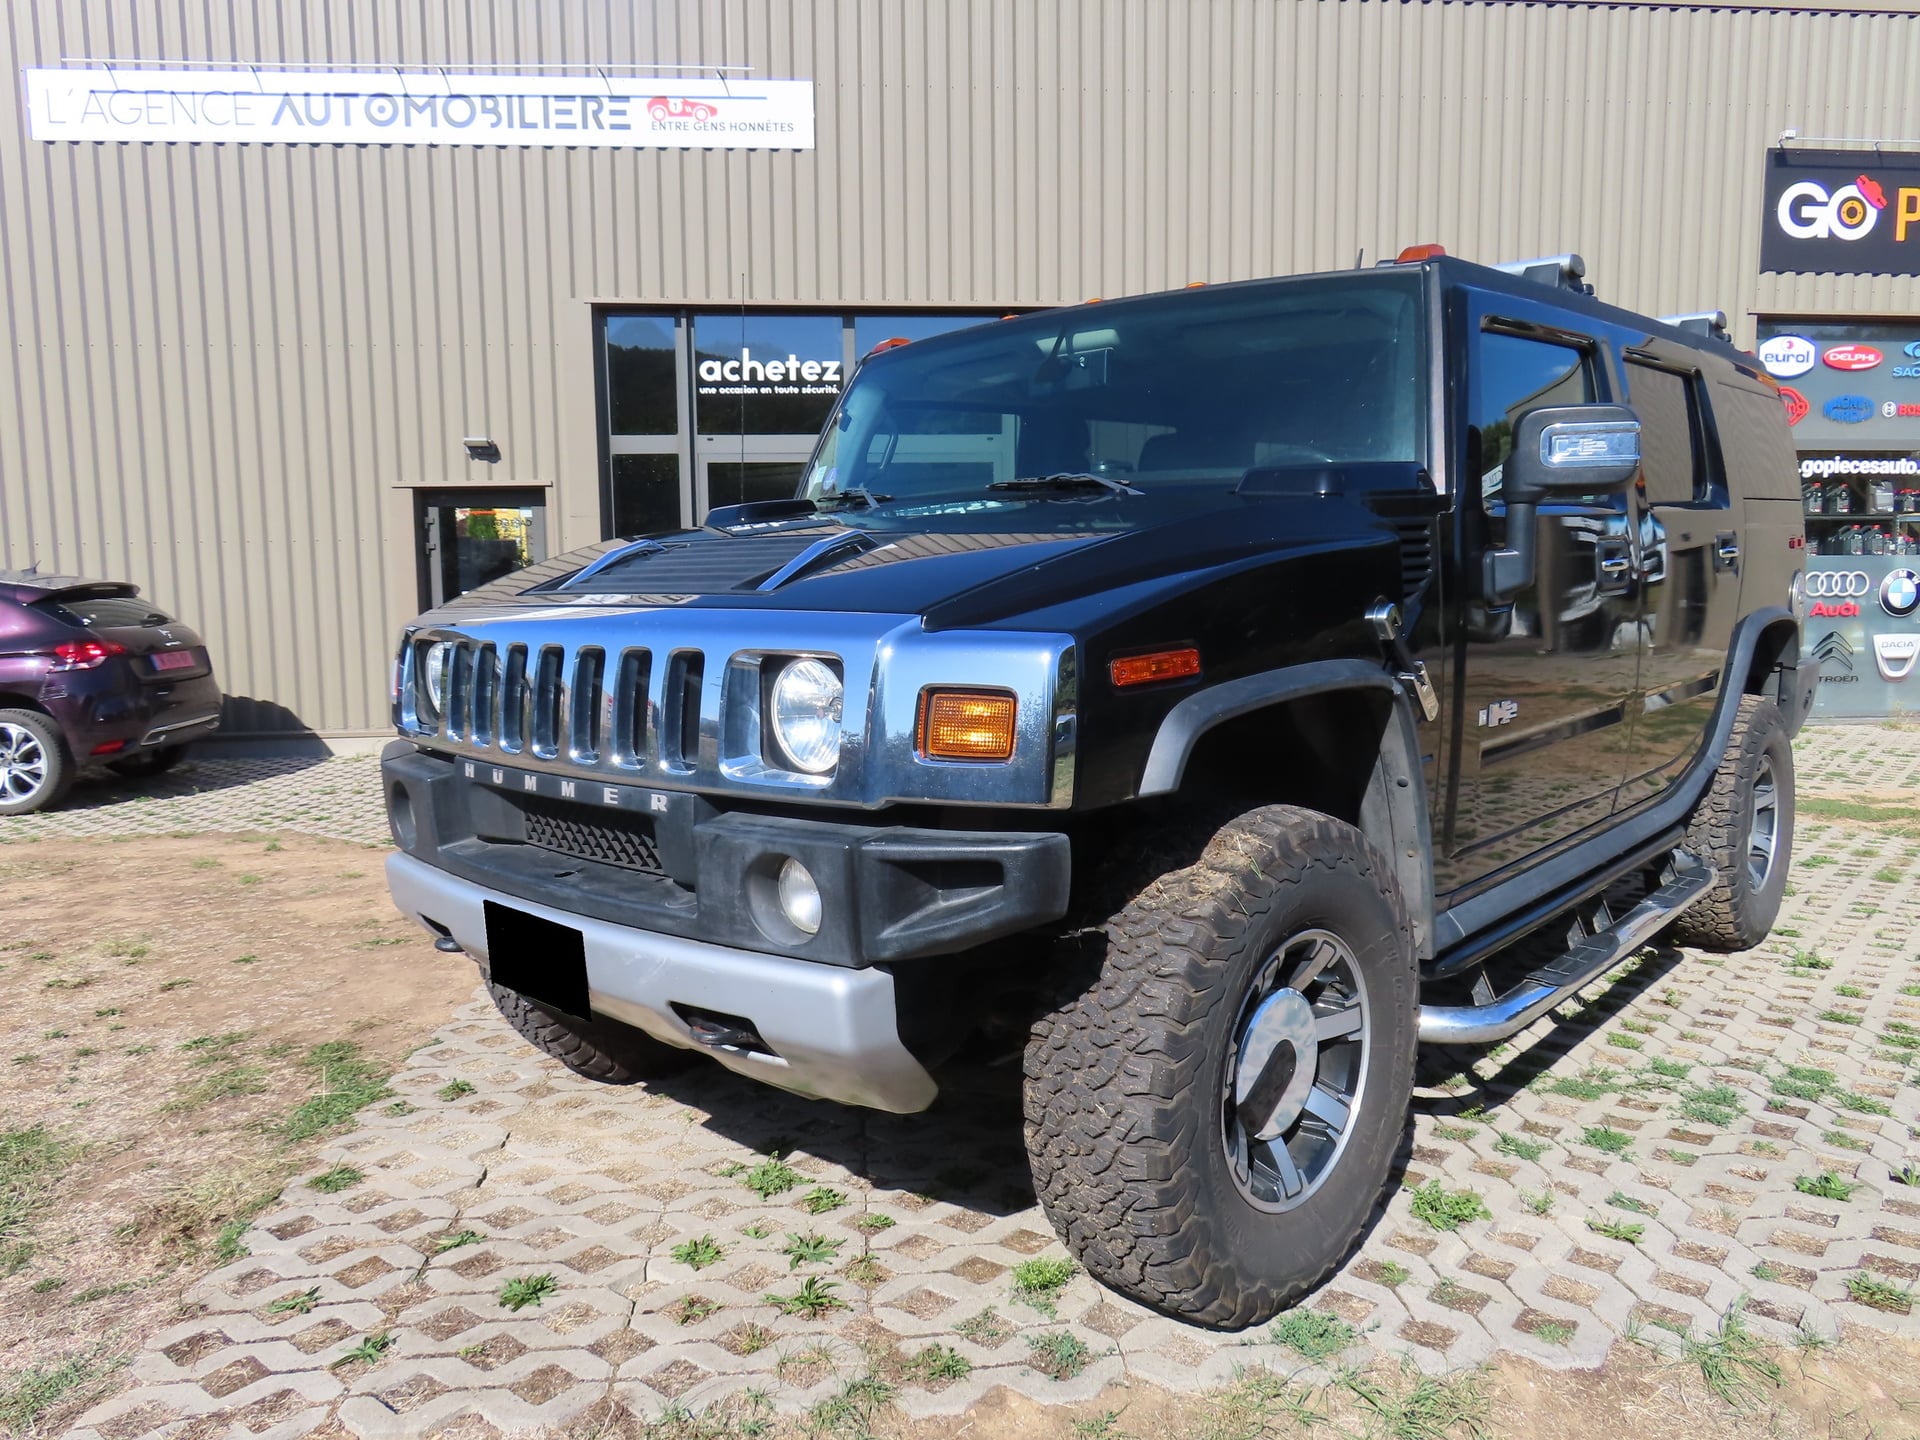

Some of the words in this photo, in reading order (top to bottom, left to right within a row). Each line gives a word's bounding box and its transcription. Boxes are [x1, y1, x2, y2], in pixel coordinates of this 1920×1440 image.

[651, 121, 690, 131] ENTRE
[693, 121, 726, 132] GENS
[730, 119, 795, 132] HONNÊTES
[1777, 181, 1878, 241] GO
[699, 347, 841, 382] achetez
[1764, 350, 1811, 364] eurol
[1828, 352, 1877, 362] DELPHI
[699, 386, 717, 395] une
[719, 384, 759, 395] occasion
[760, 386, 773, 395] en
[774, 384, 800, 395] toute
[801, 383, 841, 395] sécurité.
[1808, 601, 1860, 618] Audi
[464, 762, 668, 812] HUMMER
